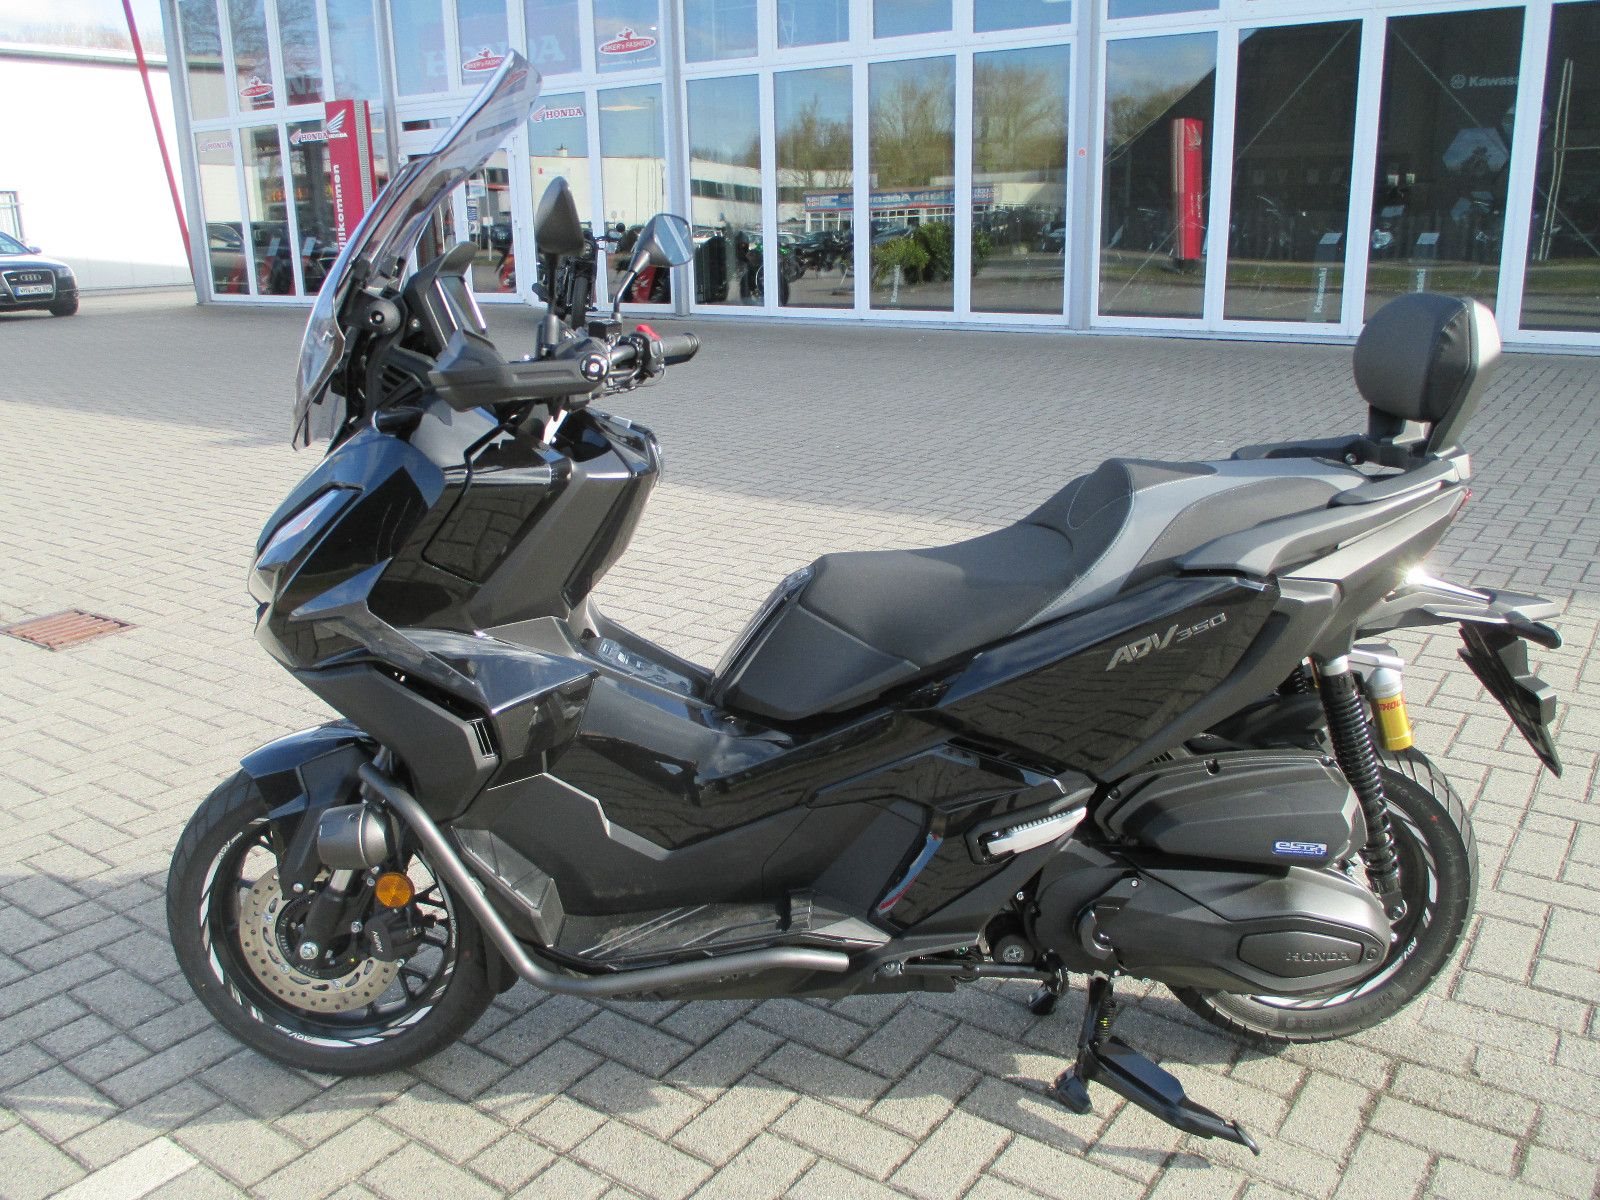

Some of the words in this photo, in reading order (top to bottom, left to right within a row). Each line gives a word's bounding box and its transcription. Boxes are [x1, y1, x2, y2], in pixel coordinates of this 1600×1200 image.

[545, 108, 582, 119] HONDA
[301, 131, 329, 141] HONDA
[1287, 951, 1351, 962] HONDA
